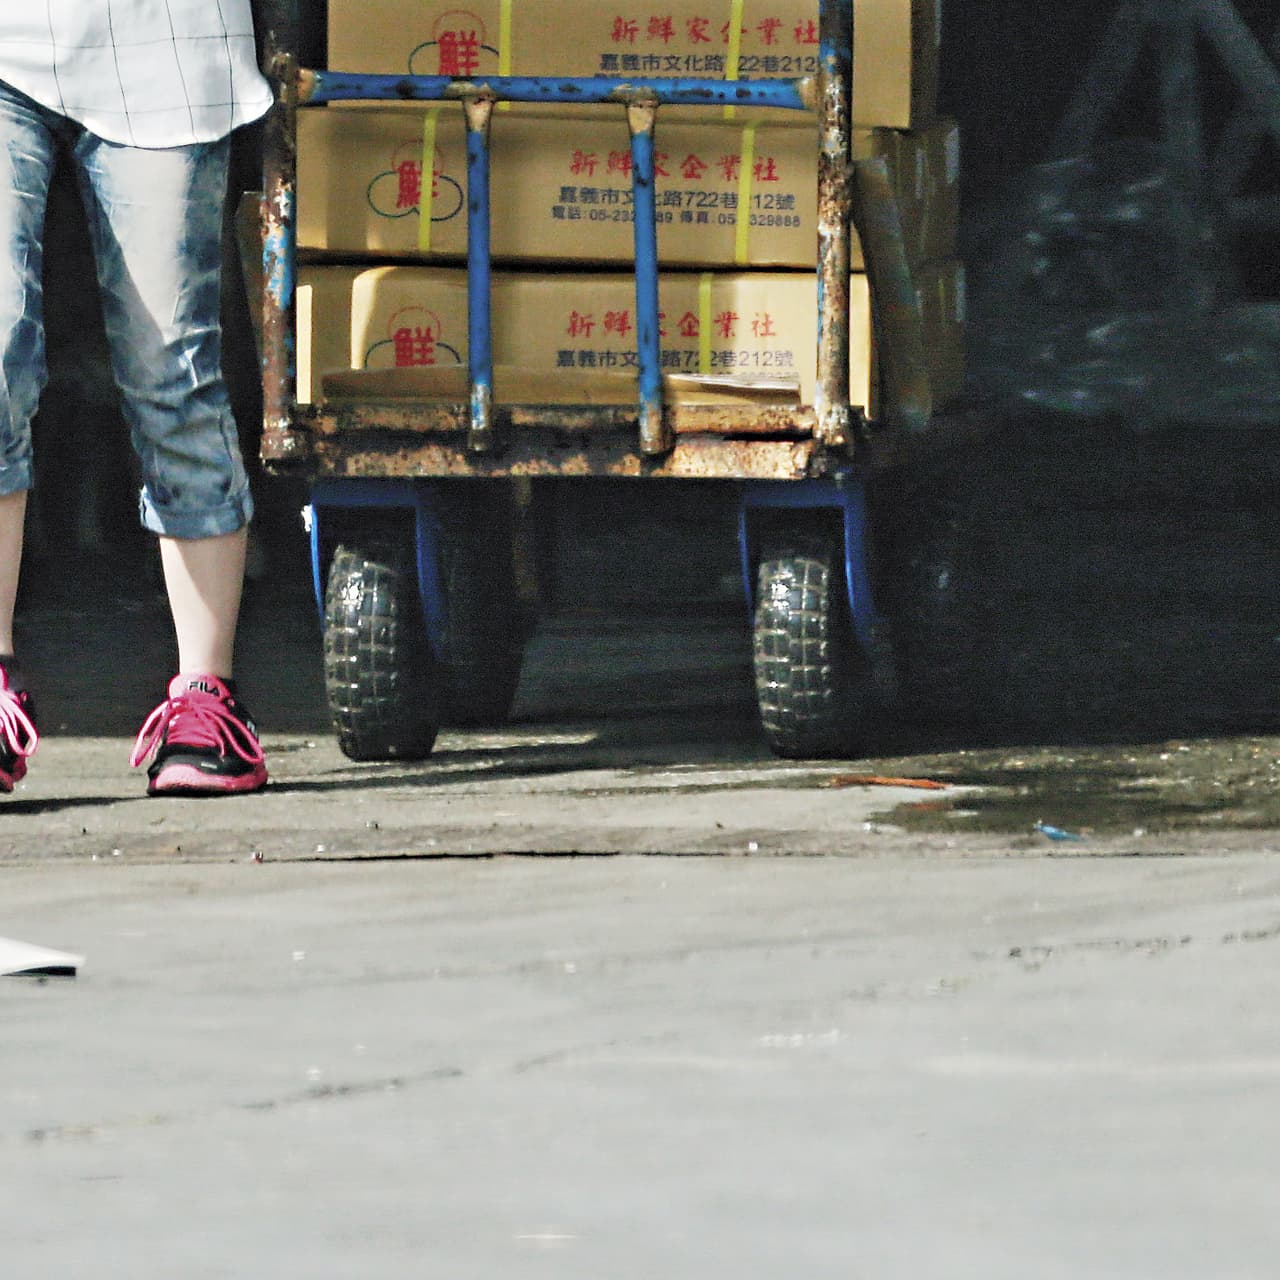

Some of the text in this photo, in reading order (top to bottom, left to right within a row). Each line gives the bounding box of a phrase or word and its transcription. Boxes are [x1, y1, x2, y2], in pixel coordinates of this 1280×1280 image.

[600, 53, 819, 73] 嘉義市文化路22巷212
[559, 186, 796, 210] 嘉義市文路722巷12號
[567, 310, 777, 338] 新鮮企業社
[556, 350, 794, 369] 嘉義市文路72巷212號
[189, 681, 221, 697] FILA
